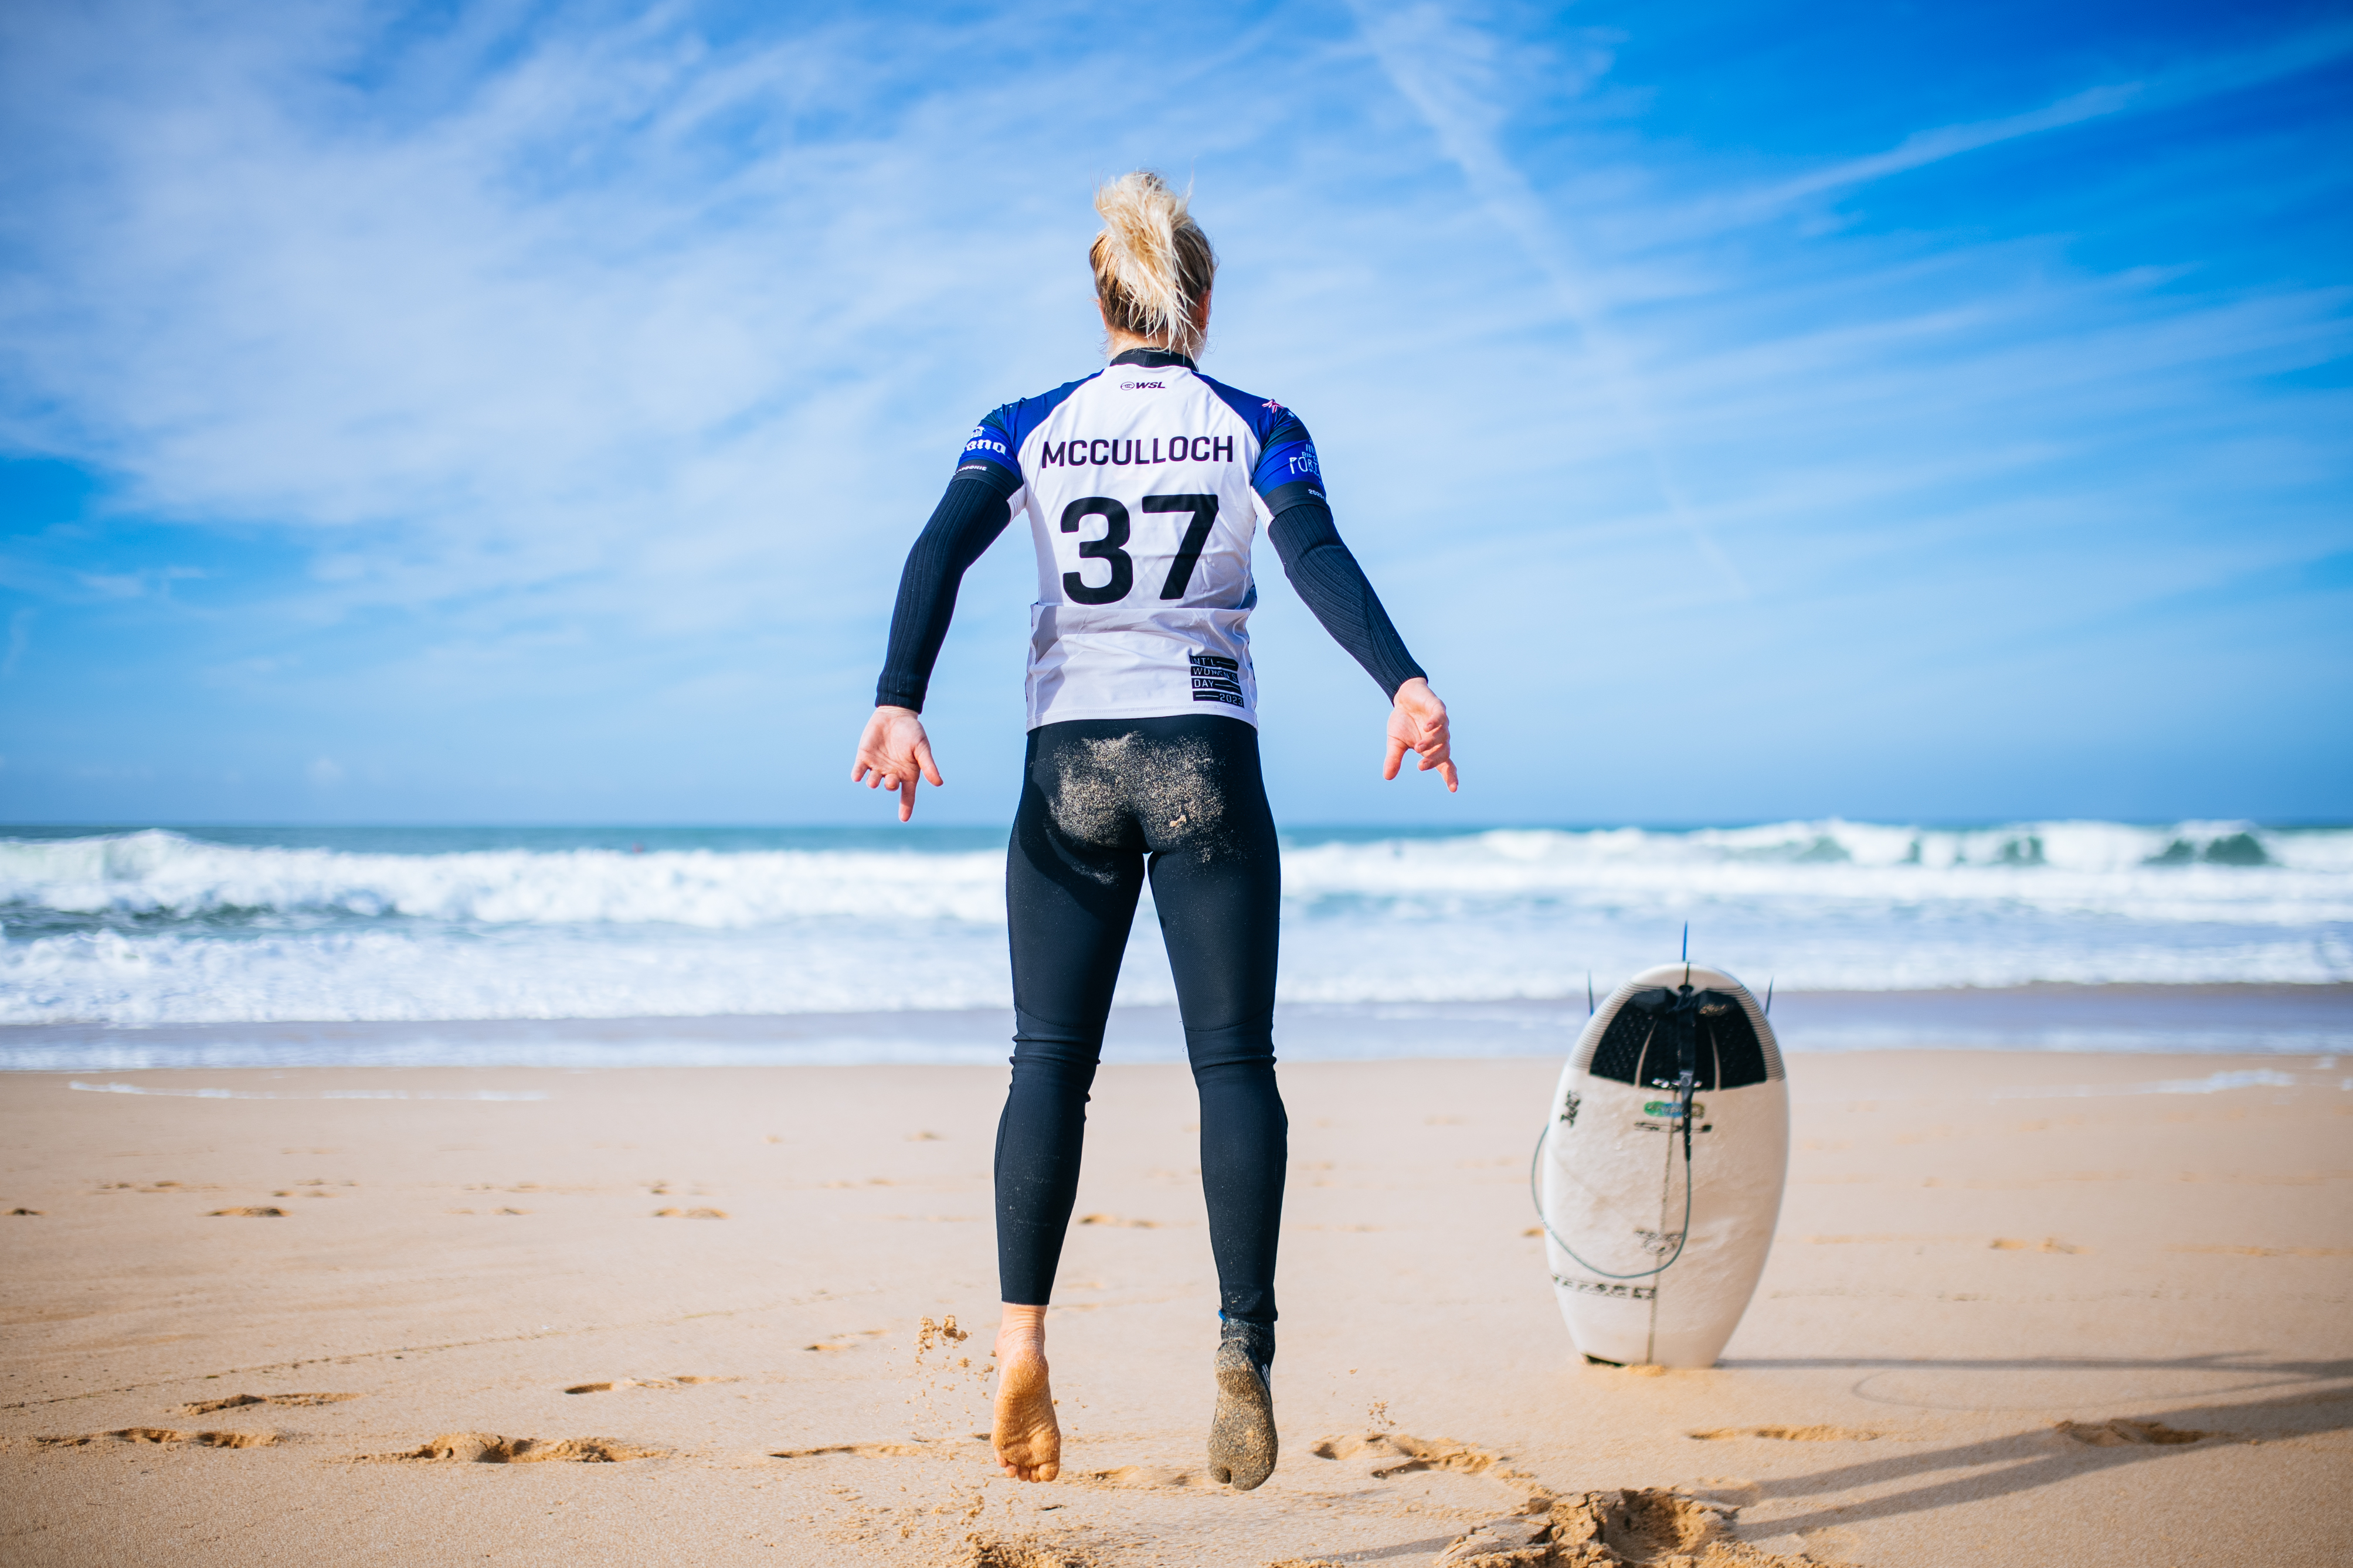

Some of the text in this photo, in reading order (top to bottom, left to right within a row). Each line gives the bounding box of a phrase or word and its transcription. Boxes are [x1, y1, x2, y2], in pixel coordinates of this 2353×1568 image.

[1136, 381, 1166, 389] WSL
[1041, 436, 1233, 469] MCCULLOCH
[1289, 457, 1318, 474] PORT
[1060, 494, 1220, 606] 37
[1191, 657, 1216, 666] INT'L
[1194, 679, 1214, 688] DAY
[1220, 693, 1242, 706] 2023
